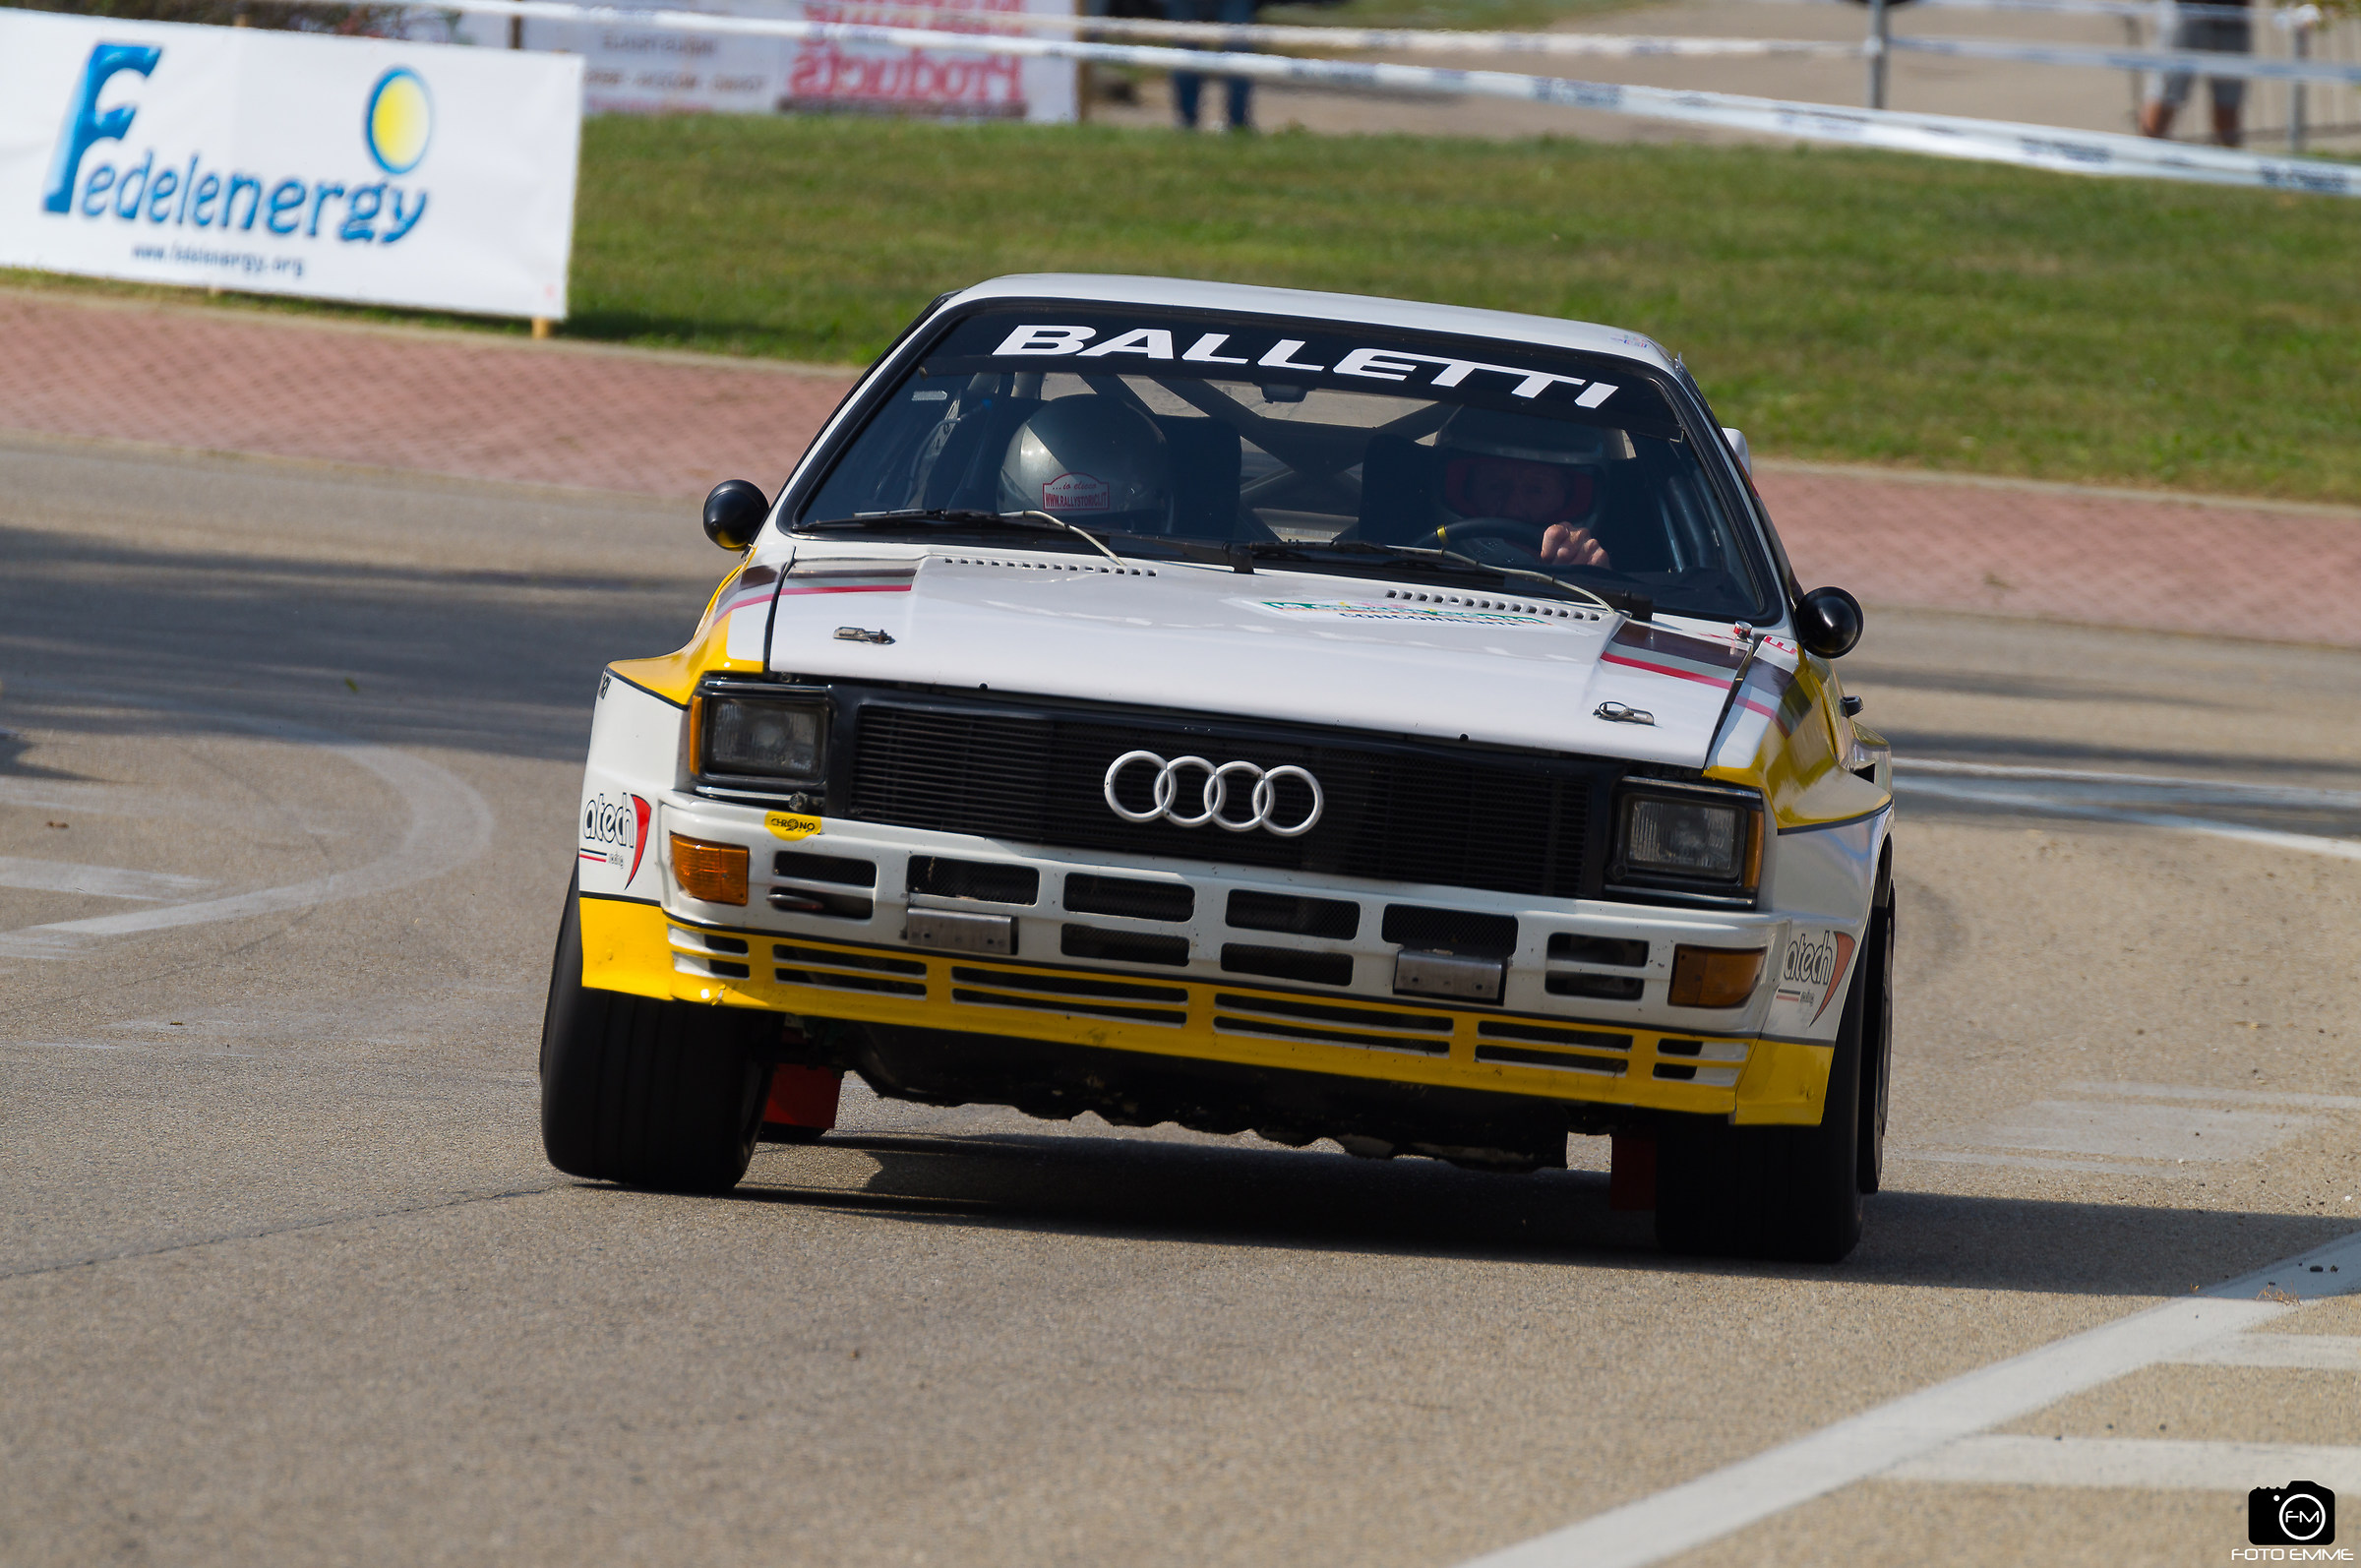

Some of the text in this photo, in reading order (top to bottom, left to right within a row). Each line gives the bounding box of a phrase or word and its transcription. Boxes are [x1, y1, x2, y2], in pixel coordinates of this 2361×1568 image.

[41, 42, 430, 245] Fedelenergy
[991, 324, 1619, 409] BALLETTI
[771, 817, 816, 831] CHRONO
